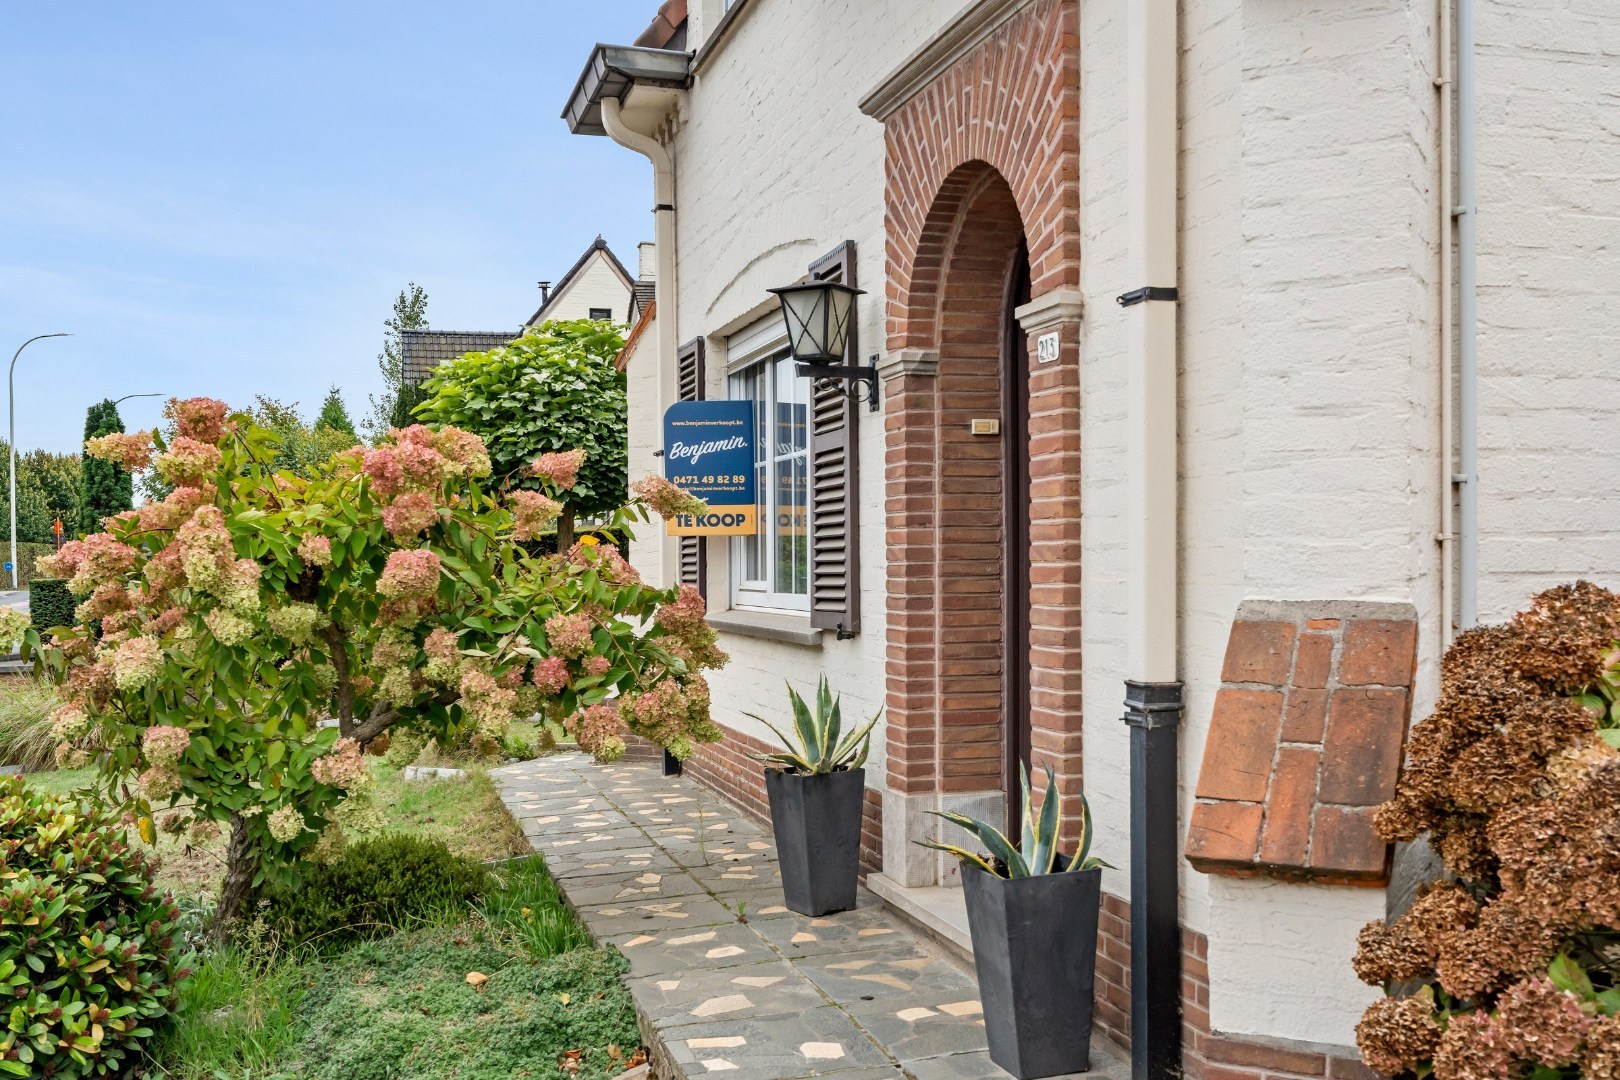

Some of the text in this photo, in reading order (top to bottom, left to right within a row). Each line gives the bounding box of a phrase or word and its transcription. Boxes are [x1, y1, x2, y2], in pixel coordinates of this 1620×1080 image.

[1039, 337, 1056, 360] 213
[672, 419, 744, 427] www.benjaminverkoopt.be
[673, 475, 745, 484] 0471 49 82 89
[675, 514, 693, 527] TE
[696, 513, 746, 527] KOOP
